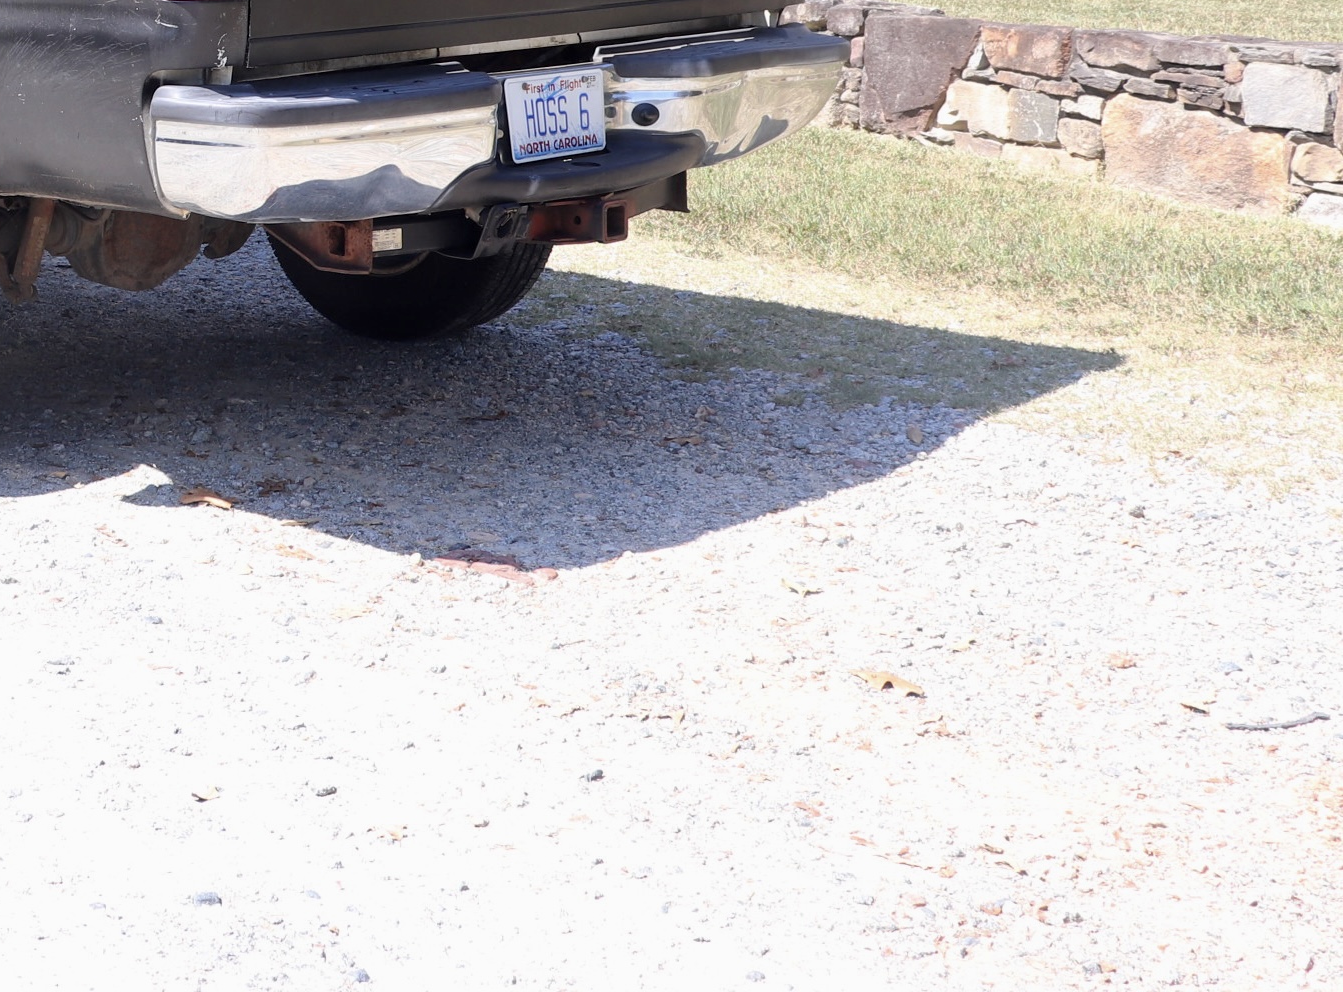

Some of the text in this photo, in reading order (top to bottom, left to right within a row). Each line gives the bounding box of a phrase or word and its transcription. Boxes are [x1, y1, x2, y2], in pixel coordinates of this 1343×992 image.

[525, 78, 582, 94] First in Flight
[524, 93, 590, 139] HOSS 6
[519, 133, 598, 156] NORTH CAROLINA
